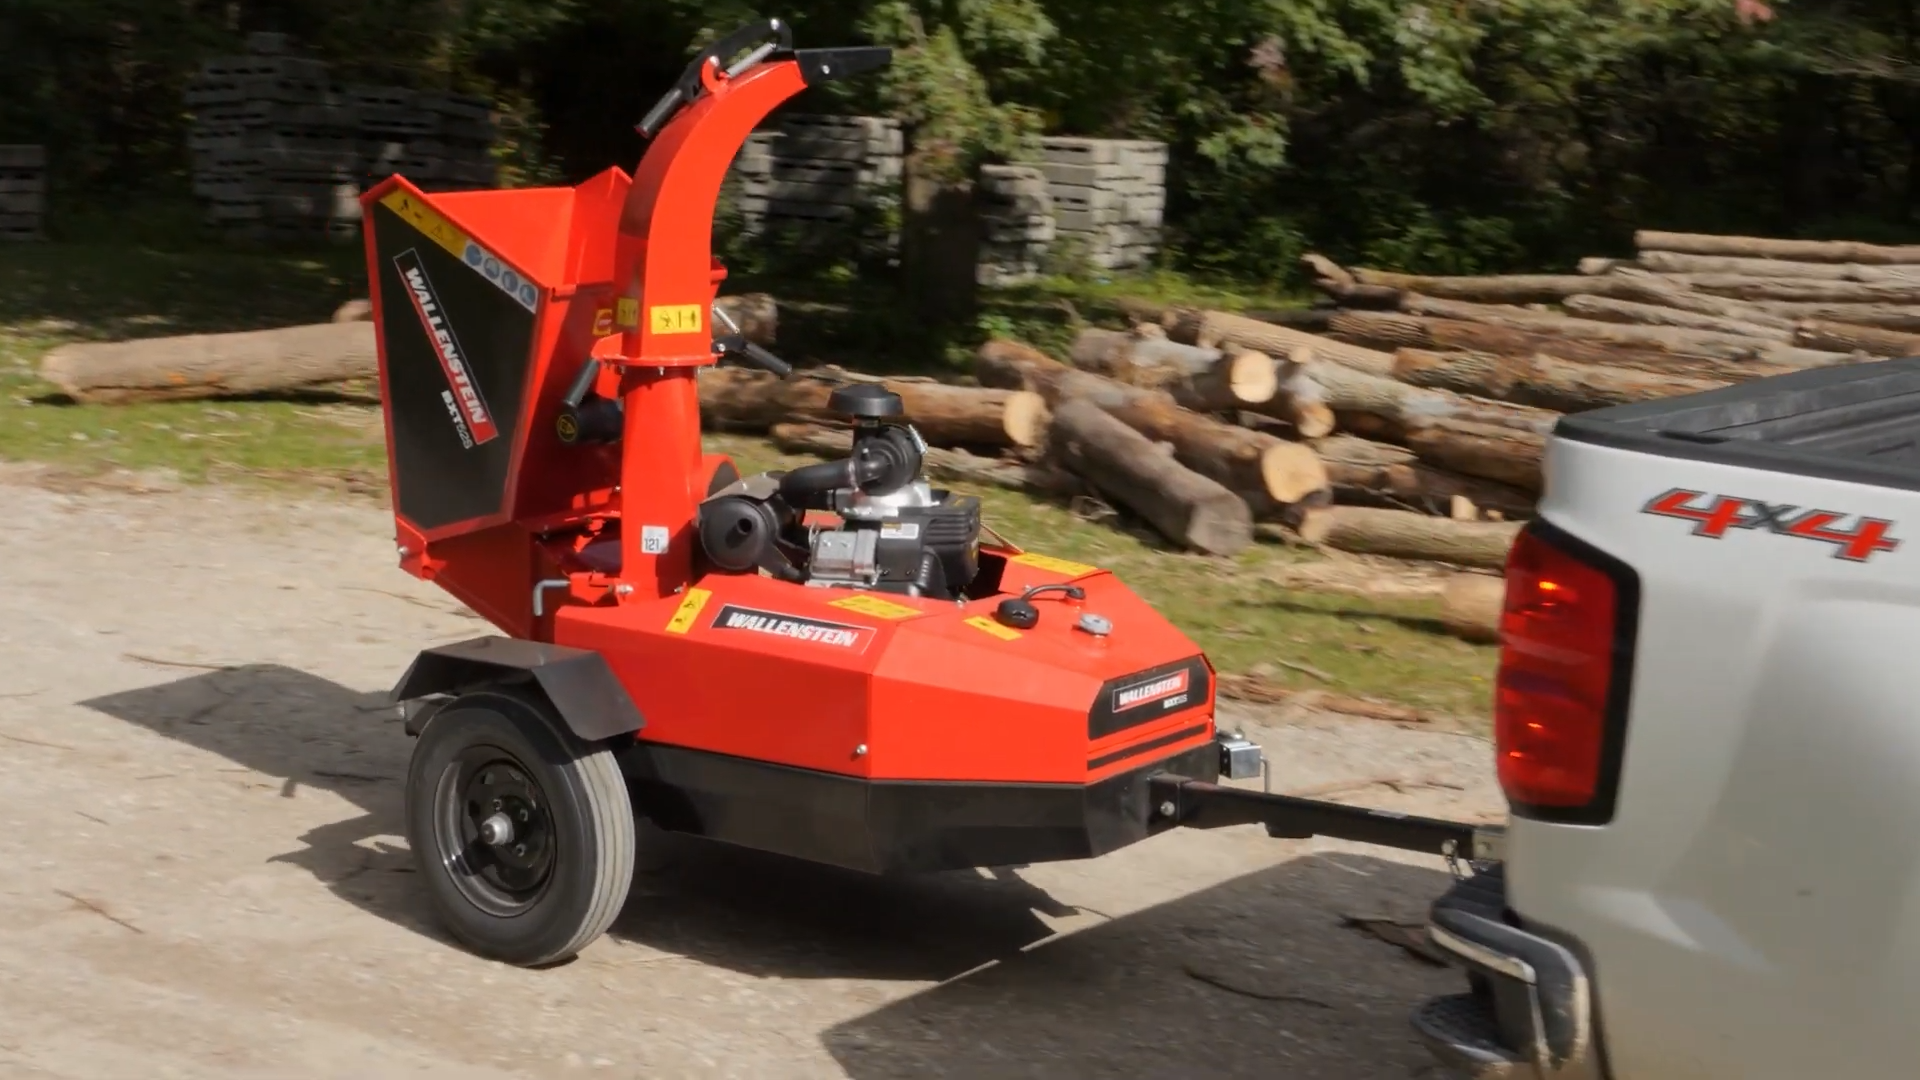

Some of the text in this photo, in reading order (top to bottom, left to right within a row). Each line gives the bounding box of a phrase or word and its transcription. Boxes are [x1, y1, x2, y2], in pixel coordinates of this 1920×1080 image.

[405, 266, 487, 424] WALLENSTEIN
[645, 537, 660, 551] 121
[726, 612, 859, 647] WALLENSTEIN
